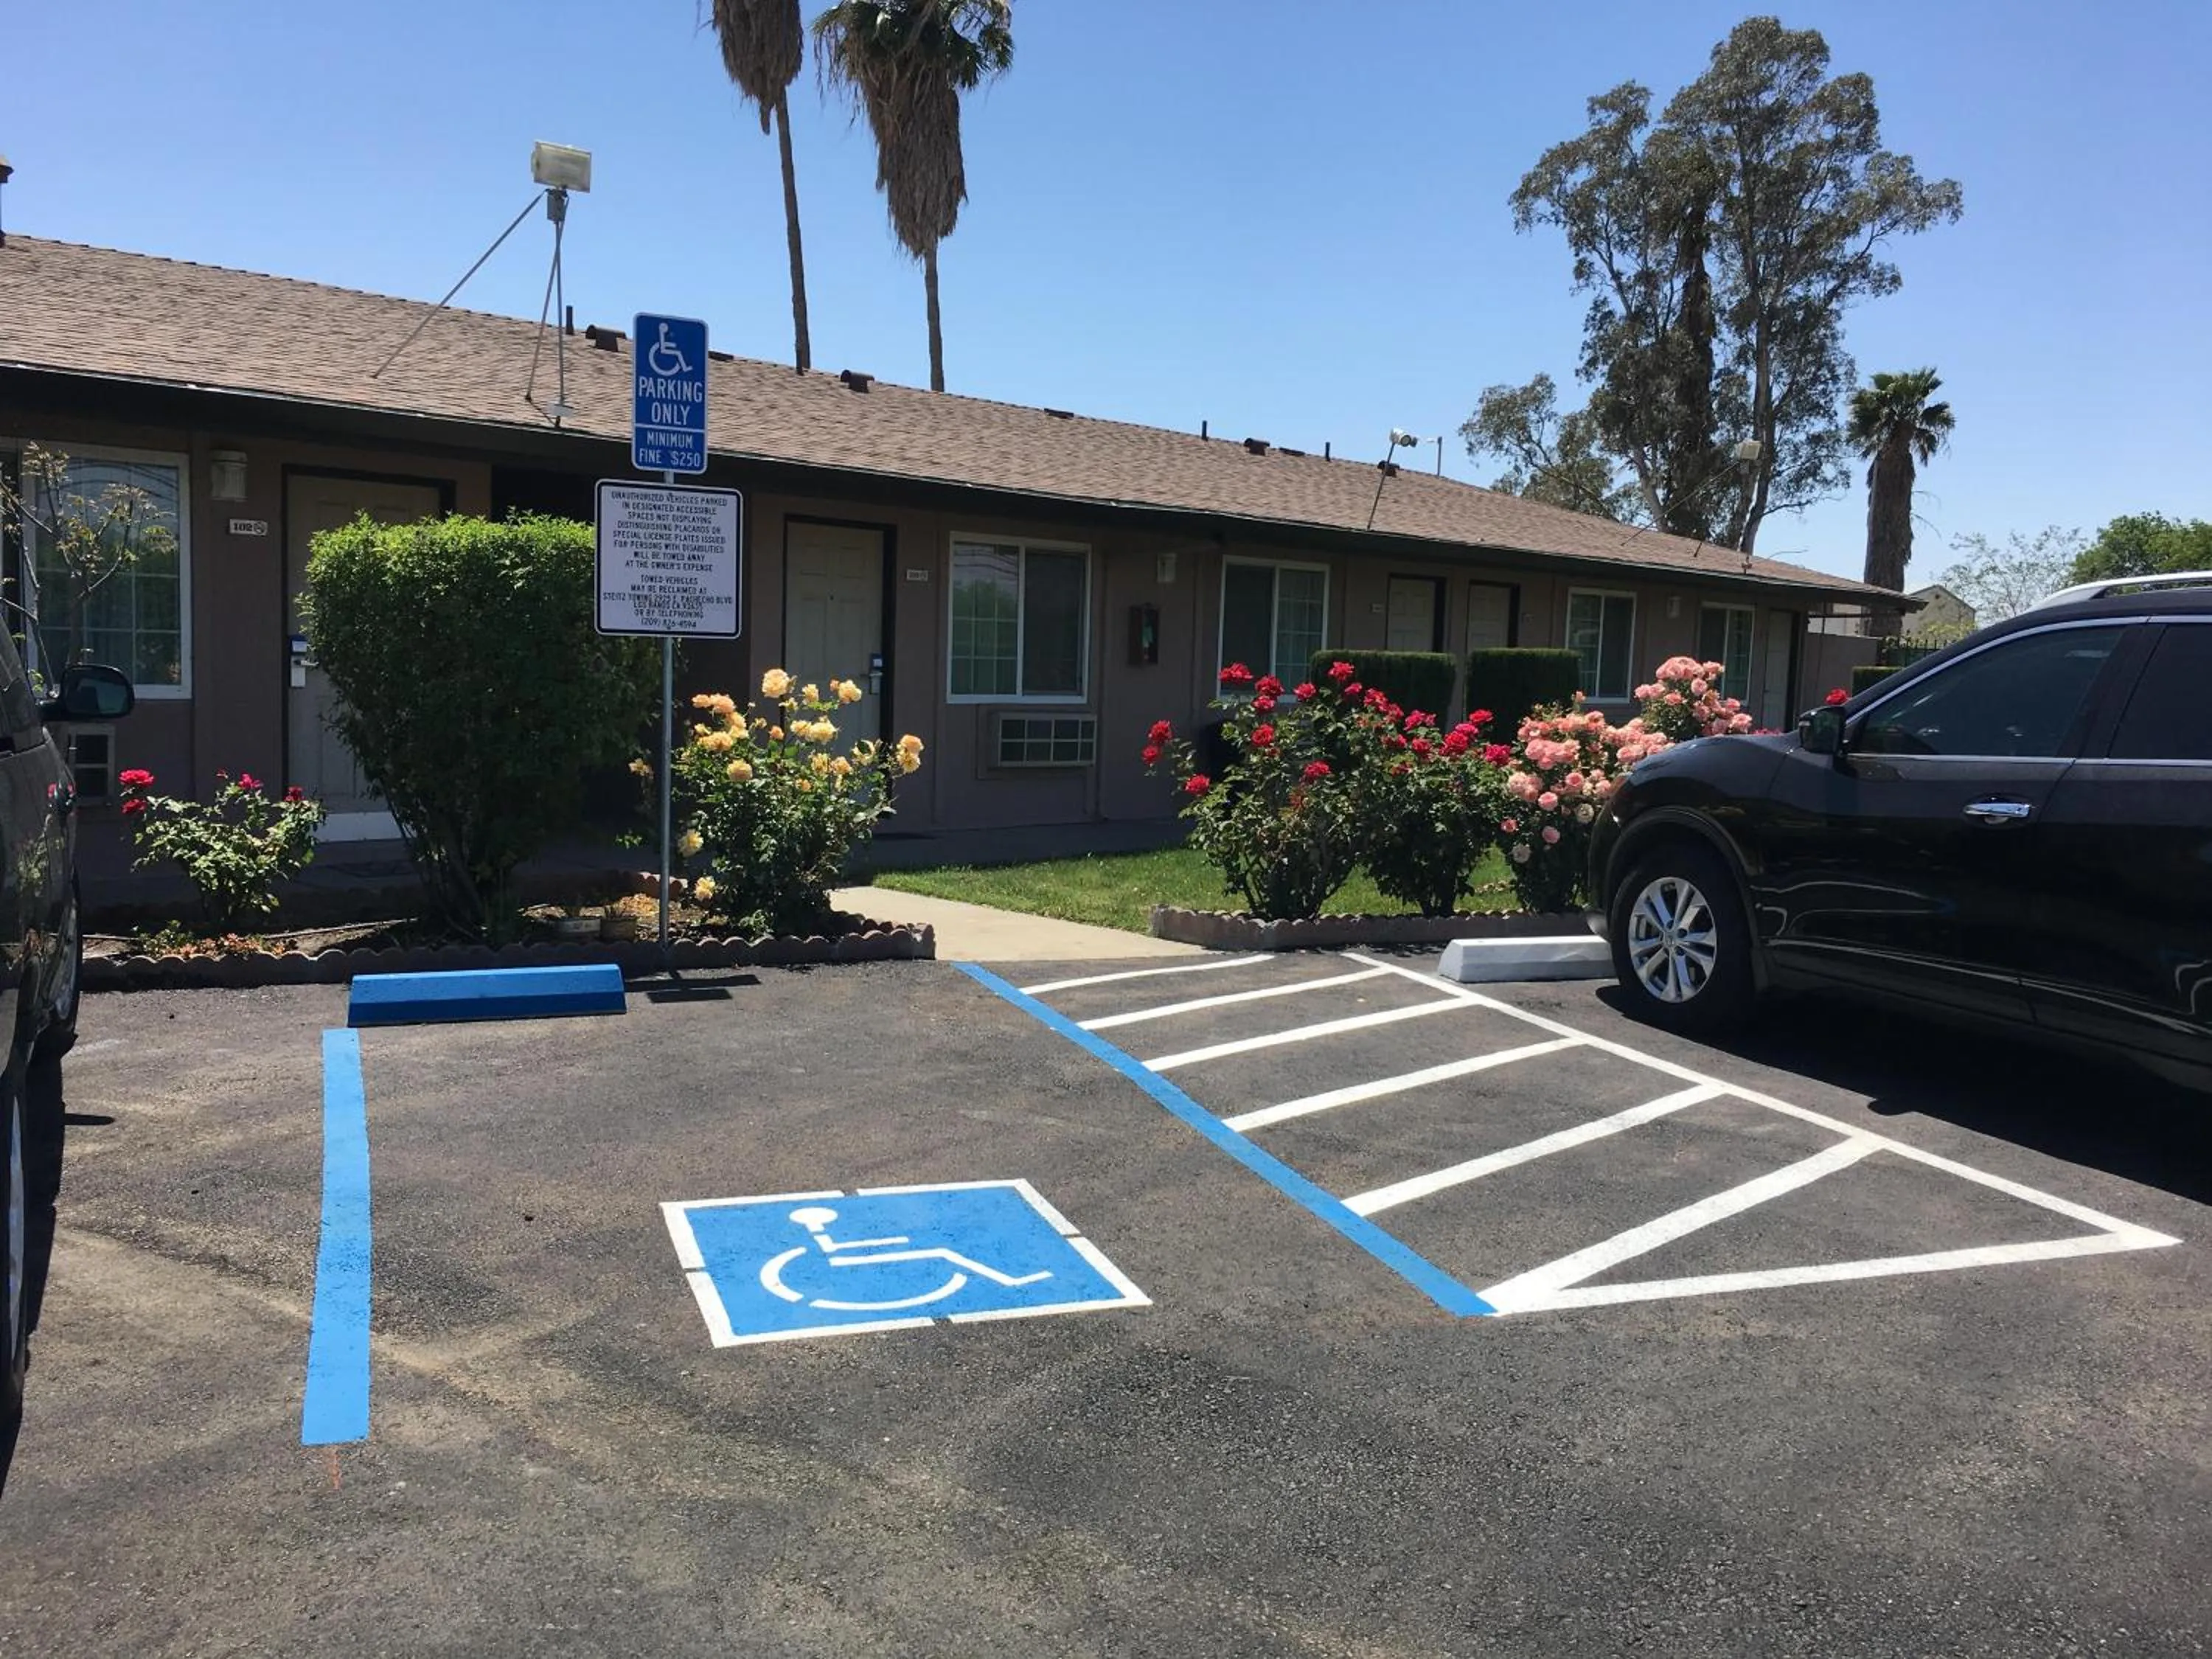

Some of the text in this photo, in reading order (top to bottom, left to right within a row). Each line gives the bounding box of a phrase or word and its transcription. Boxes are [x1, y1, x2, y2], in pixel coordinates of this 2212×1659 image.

[639, 377, 703, 403] PARKING
[652, 402, 690, 425] ONLY
[647, 430, 692, 449] MINIMUM
[640, 448, 700, 467] FINE $250
[612, 491, 728, 507] UNAUTHORIZED VEHICLES PARKED
[633, 502, 674, 512] DESIGNATED
[676, 505, 717, 515] ACCESSIBLE
[627, 512, 712, 524] SPACES NOT DISPLAYING
[234, 522, 253, 532] 102
[618, 521, 672, 531] DISTINGUISHING
[675, 524, 709, 534] PLACARDS
[613, 530, 726, 544] SPECIAL LICENSE PLATES ISSUED
[630, 541, 661, 550] PERSONS
[682, 544, 724, 553] DISABILITIES
[652, 552, 661, 560] BE
[663, 552, 685, 561] TOWED
[687, 554, 705, 562] AWAY
[625, 560, 633, 568] AT
[636, 560, 649, 568] THE
[683, 563, 713, 571] EXPENSE
[641, 575, 698, 585] TOWED VEHICLES
[649, 585, 656, 593] BE
[659, 585, 697, 594] RECLAIMED
